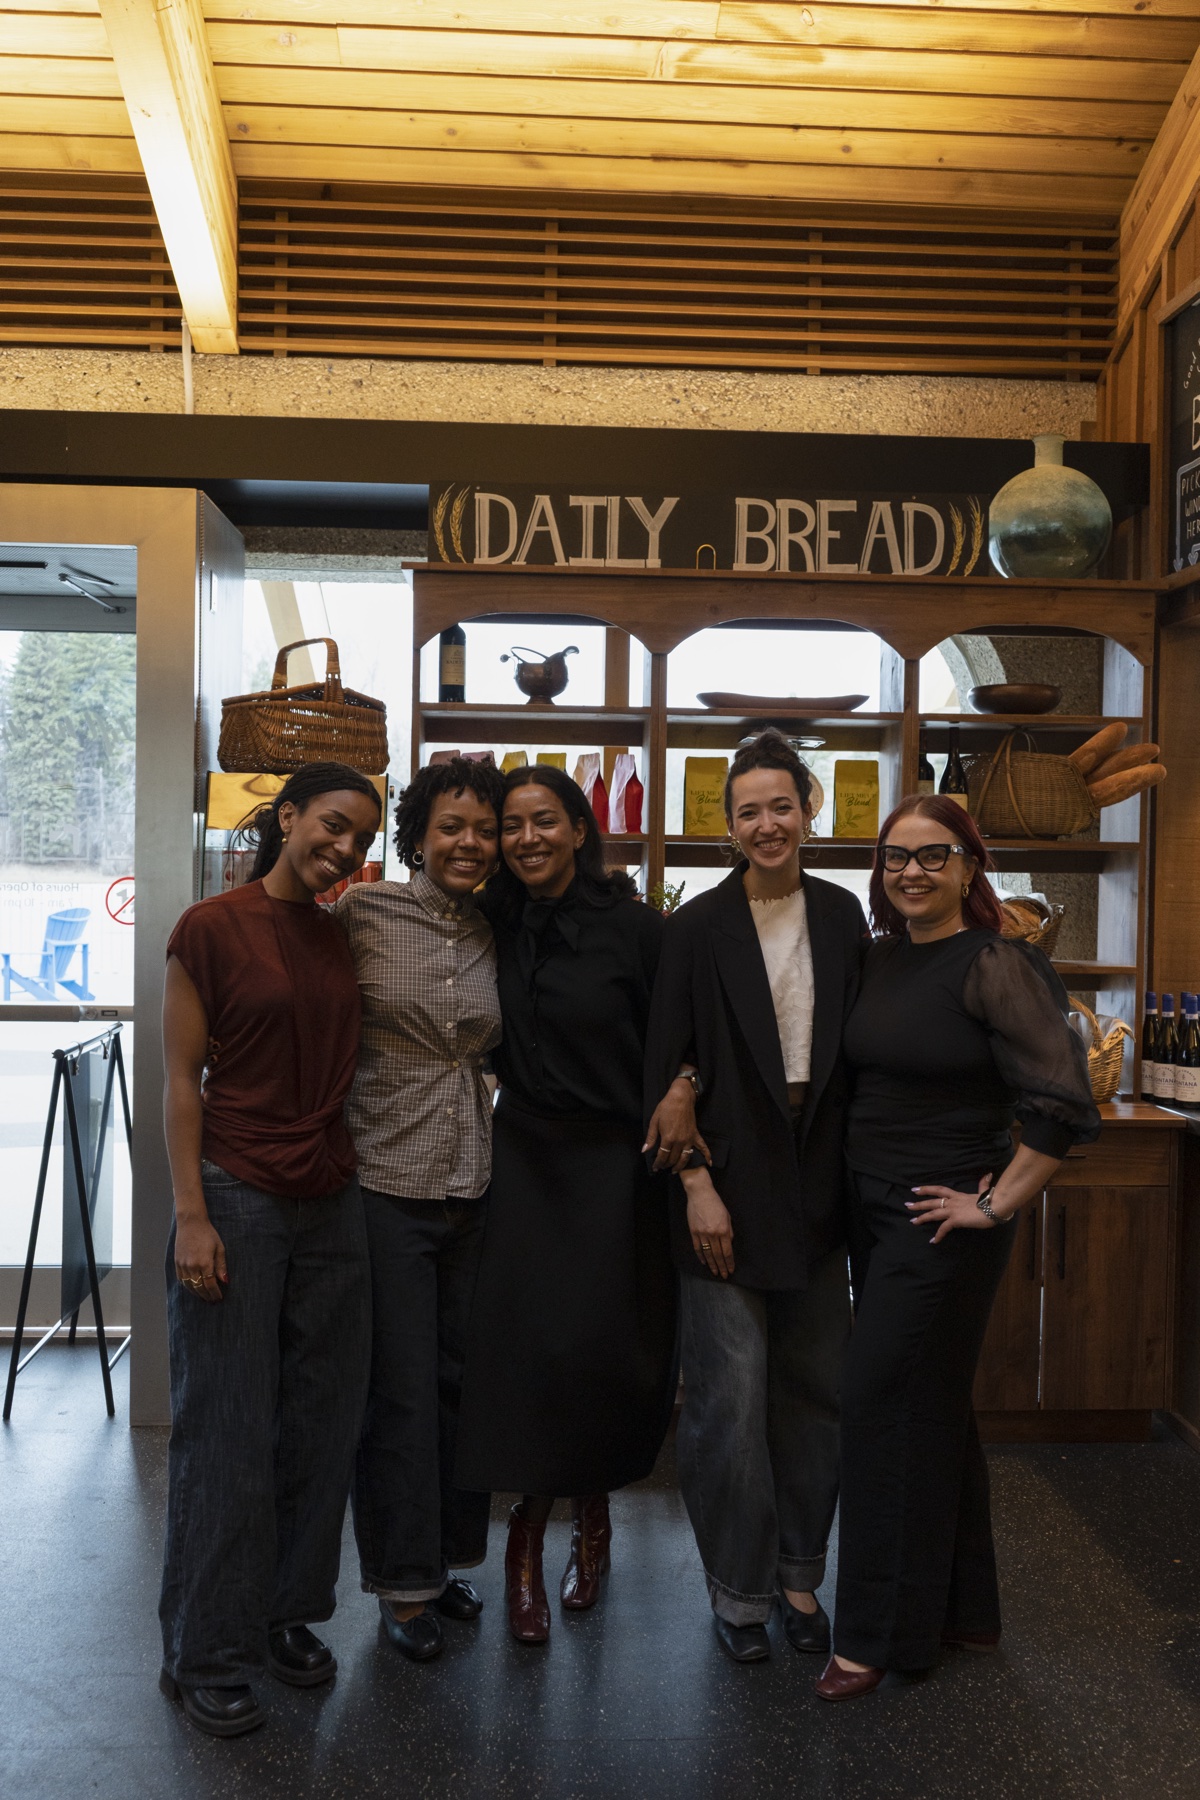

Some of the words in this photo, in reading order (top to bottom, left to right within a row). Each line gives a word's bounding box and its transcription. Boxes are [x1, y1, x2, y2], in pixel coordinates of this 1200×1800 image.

[473, 492, 680, 568] DAILY
[733, 497, 945, 576] BREAD
[696, 794, 722, 805] Blend
[845, 796, 871, 807] Blend
